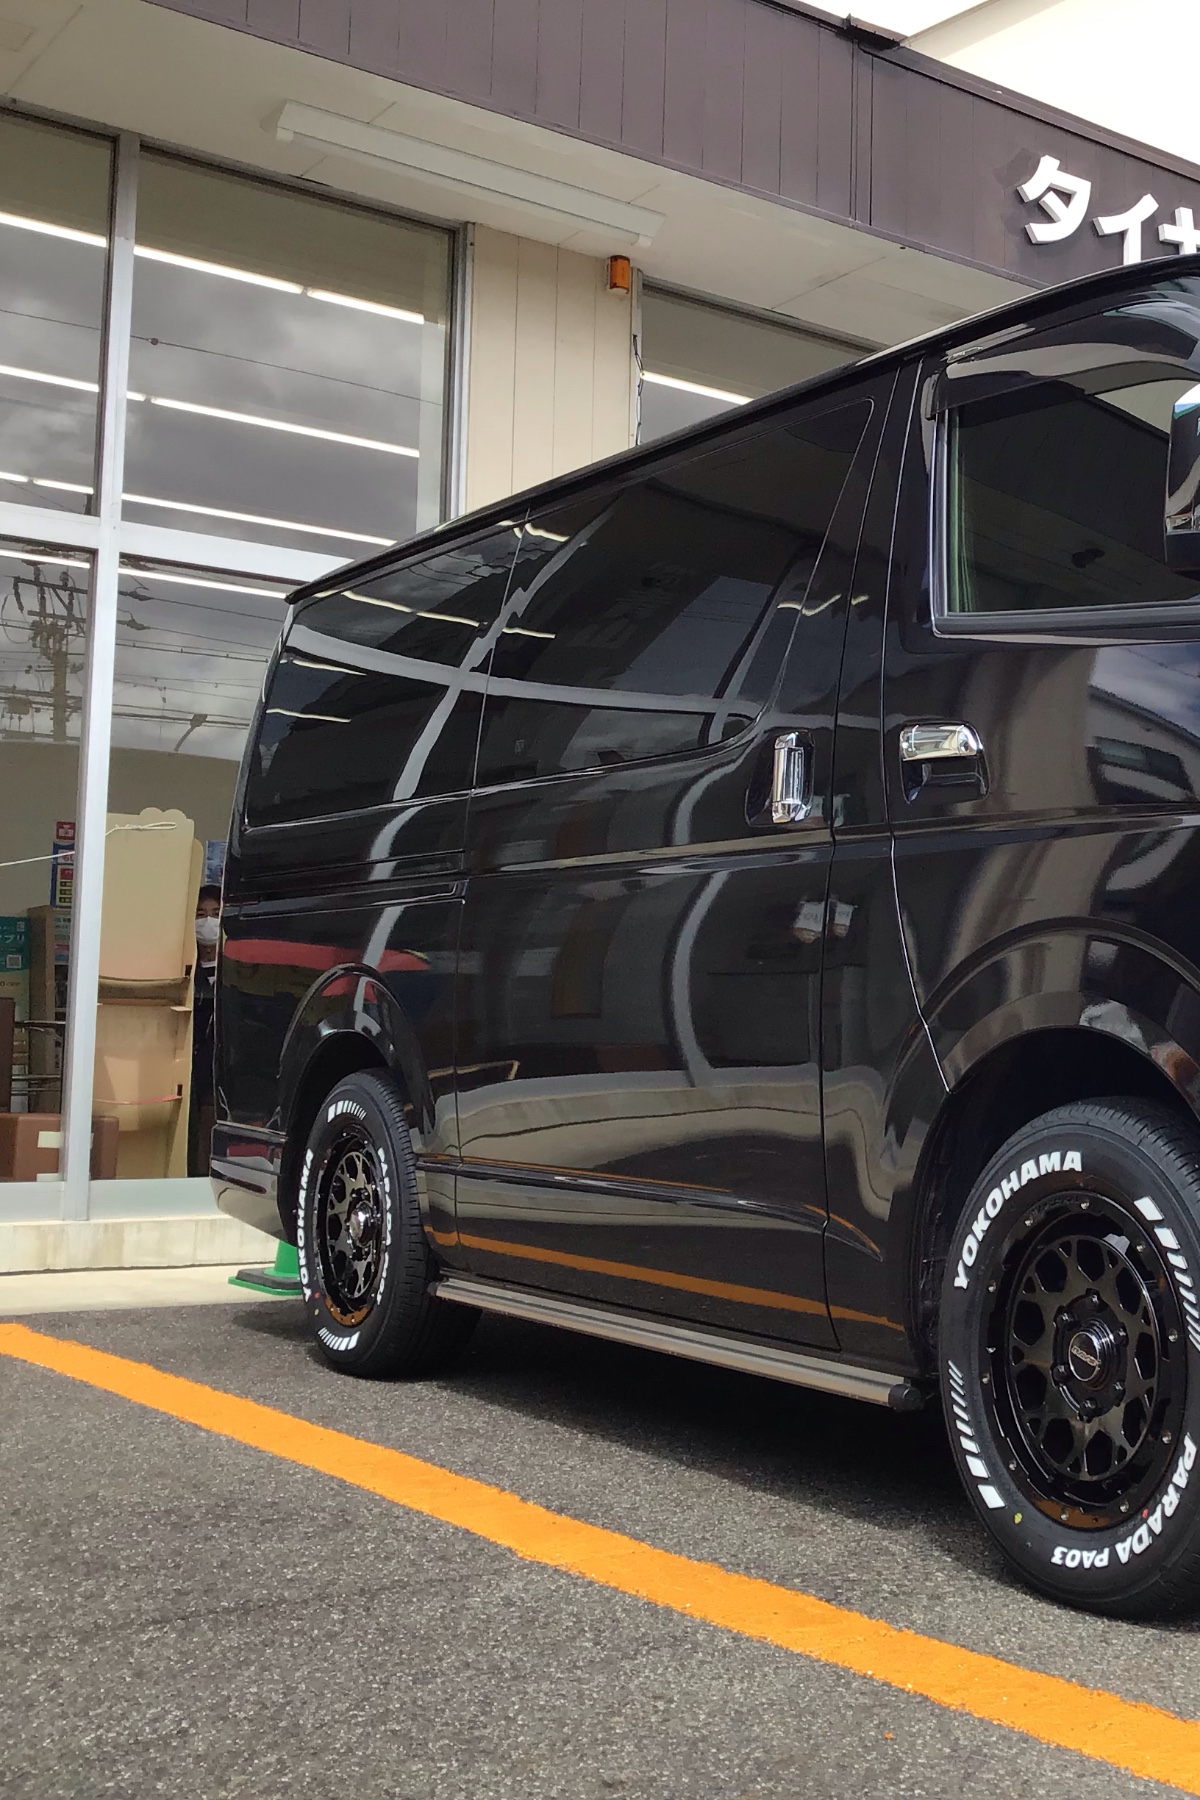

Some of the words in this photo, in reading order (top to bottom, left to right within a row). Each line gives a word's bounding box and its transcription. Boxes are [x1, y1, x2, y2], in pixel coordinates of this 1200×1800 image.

[297, 1148, 314, 1303] YOKOHAMA
[952, 1150, 1083, 1291] YOKOHAMA
[1050, 1546, 1110, 1569] PA03
[1115, 1432, 1198, 1564] PARADA
